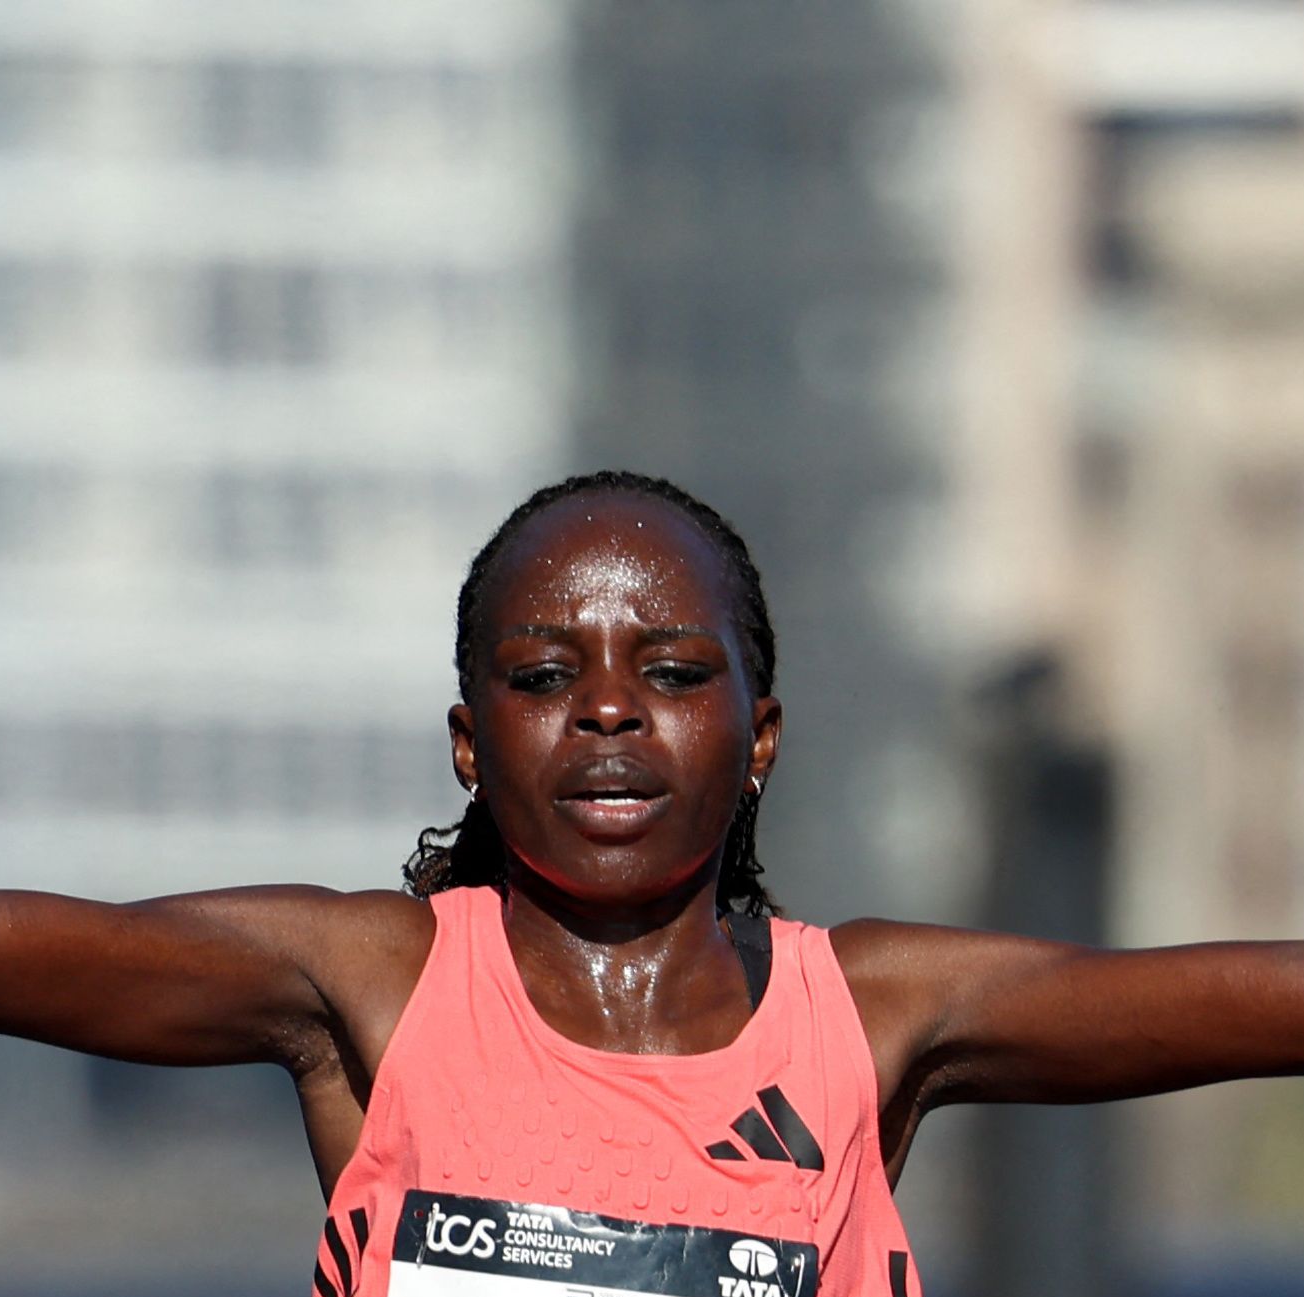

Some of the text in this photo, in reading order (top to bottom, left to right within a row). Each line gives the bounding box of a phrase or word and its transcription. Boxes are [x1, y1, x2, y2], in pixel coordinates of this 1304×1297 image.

[426, 1202, 497, 1259] tcs
[506, 1211, 555, 1232] TATA
[503, 1230, 616, 1257] CONSULTANCY
[501, 1247, 573, 1269] SERVICES
